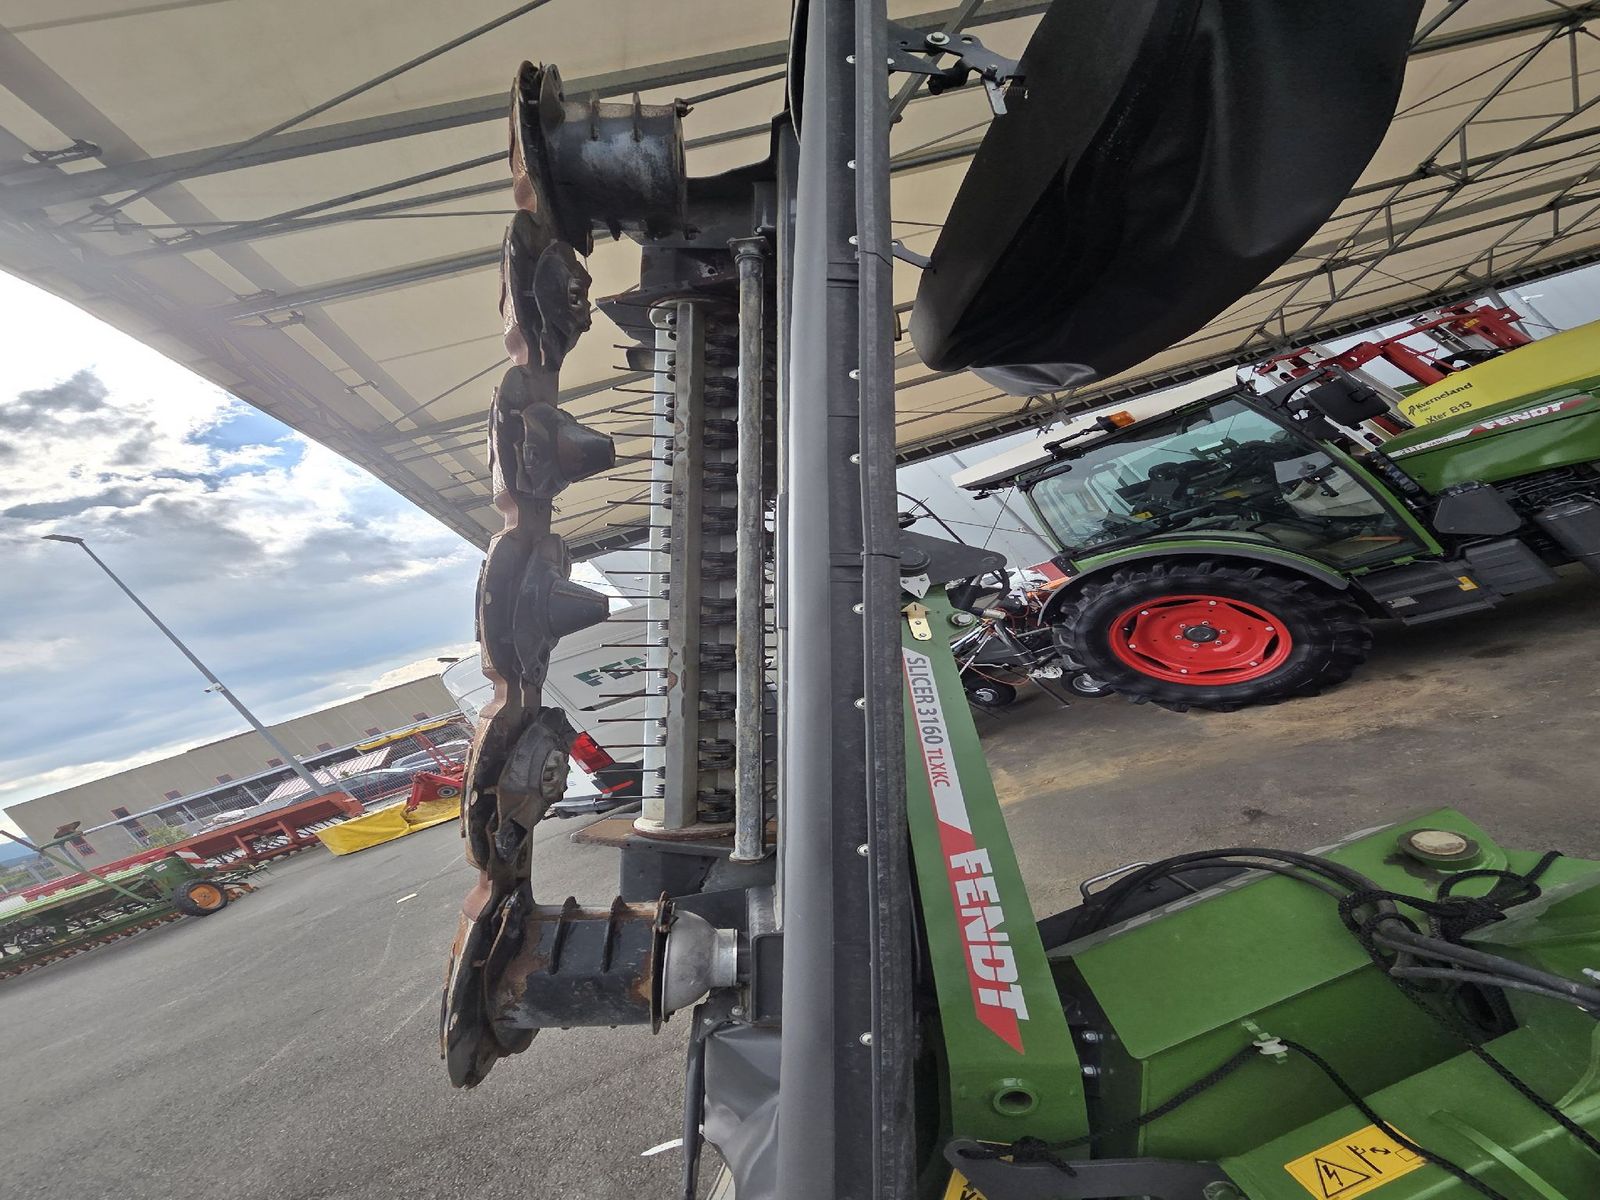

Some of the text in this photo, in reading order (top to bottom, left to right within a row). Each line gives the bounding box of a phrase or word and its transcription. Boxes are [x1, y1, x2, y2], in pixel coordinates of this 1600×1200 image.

[1415, 382, 1473, 409] Kverneland
[1479, 401, 1564, 430] FENDT
[906, 656, 951, 788] SLICER 3160 TLXKC
[949, 847, 1030, 1021] FENDT
